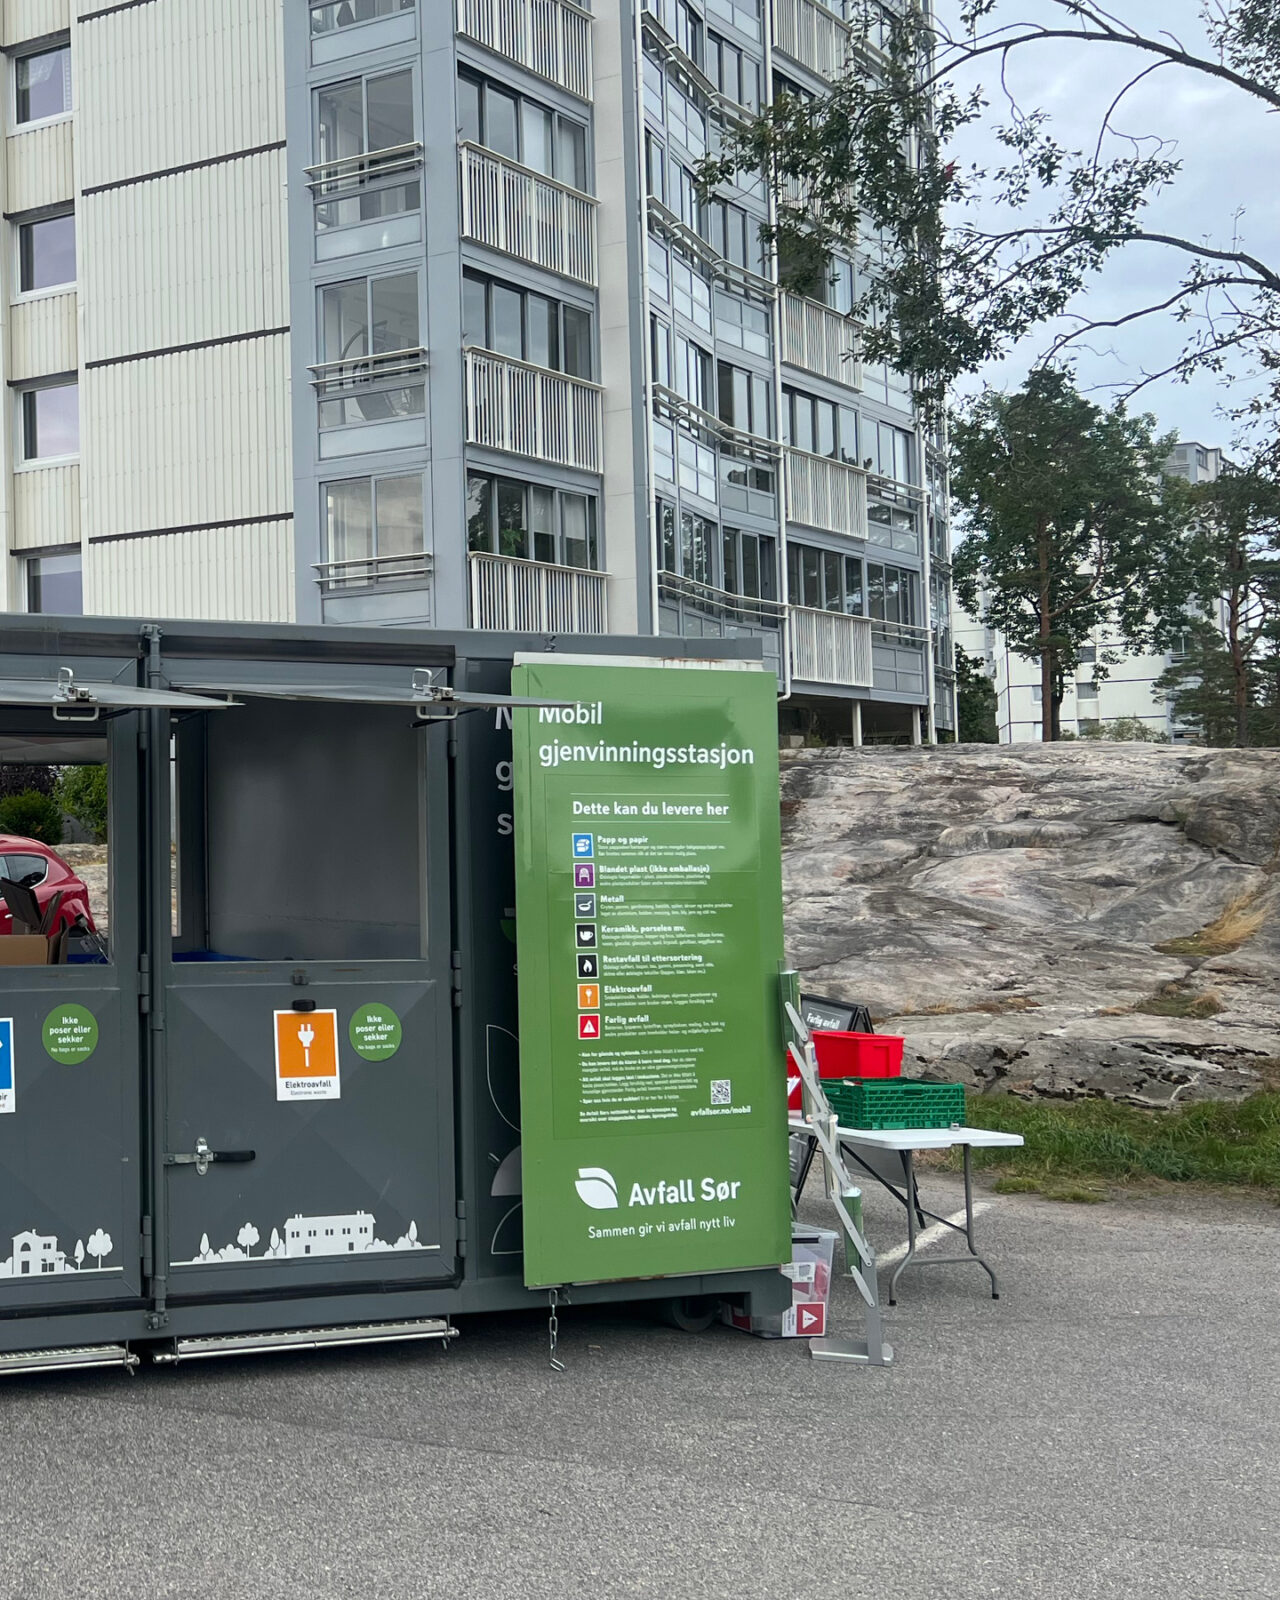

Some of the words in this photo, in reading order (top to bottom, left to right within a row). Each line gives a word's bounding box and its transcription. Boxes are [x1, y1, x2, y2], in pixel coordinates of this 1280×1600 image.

[539, 702, 602, 724] Mobil
[539, 739, 754, 769] gjenvinningsstasjon
[573, 801, 610, 815] Dette
[614, 802, 638, 815] kan
[642, 802, 659, 815] du
[662, 802, 703, 815] levere
[707, 802, 729, 815] her
[597, 835, 616, 844] Papp
[629, 836, 648, 844] papir
[599, 865, 628, 873] Blandet
[629, 865, 648, 874] plast
[649, 865, 667, 873] (ikke
[669, 865, 710, 873] emballasje)
[600, 895, 624, 903] Metall
[640, 924, 672, 934] porselen
[602, 955, 640, 963] Restavfall
[651, 954, 703, 963] ettersortering
[604, 985, 652, 993] Elektroavfall
[62, 1016, 78, 1025] Ikke
[366, 1015, 382, 1023] Ikke
[605, 1015, 627, 1025] Farlig
[628, 1015, 649, 1023] avfall
[49, 1026, 71, 1036] poser
[73, 1025, 91, 1033] eller
[356, 1025, 375, 1034] poser
[377, 1024, 394, 1032] eller
[58, 1036, 84, 1044] sekker
[363, 1033, 388, 1041] sekker
[285, 1080, 331, 1089] Elektroavfall
[629, 1179, 695, 1207] Avfall
[700, 1177, 741, 1202] Sør
[588, 1225, 635, 1239] Sammen
[638, 1223, 653, 1237] gir
[656, 1222, 665, 1233] vi
[668, 1218, 696, 1232] avfall
[699, 1217, 720, 1233] nytt
[723, 1216, 736, 1228] liv
